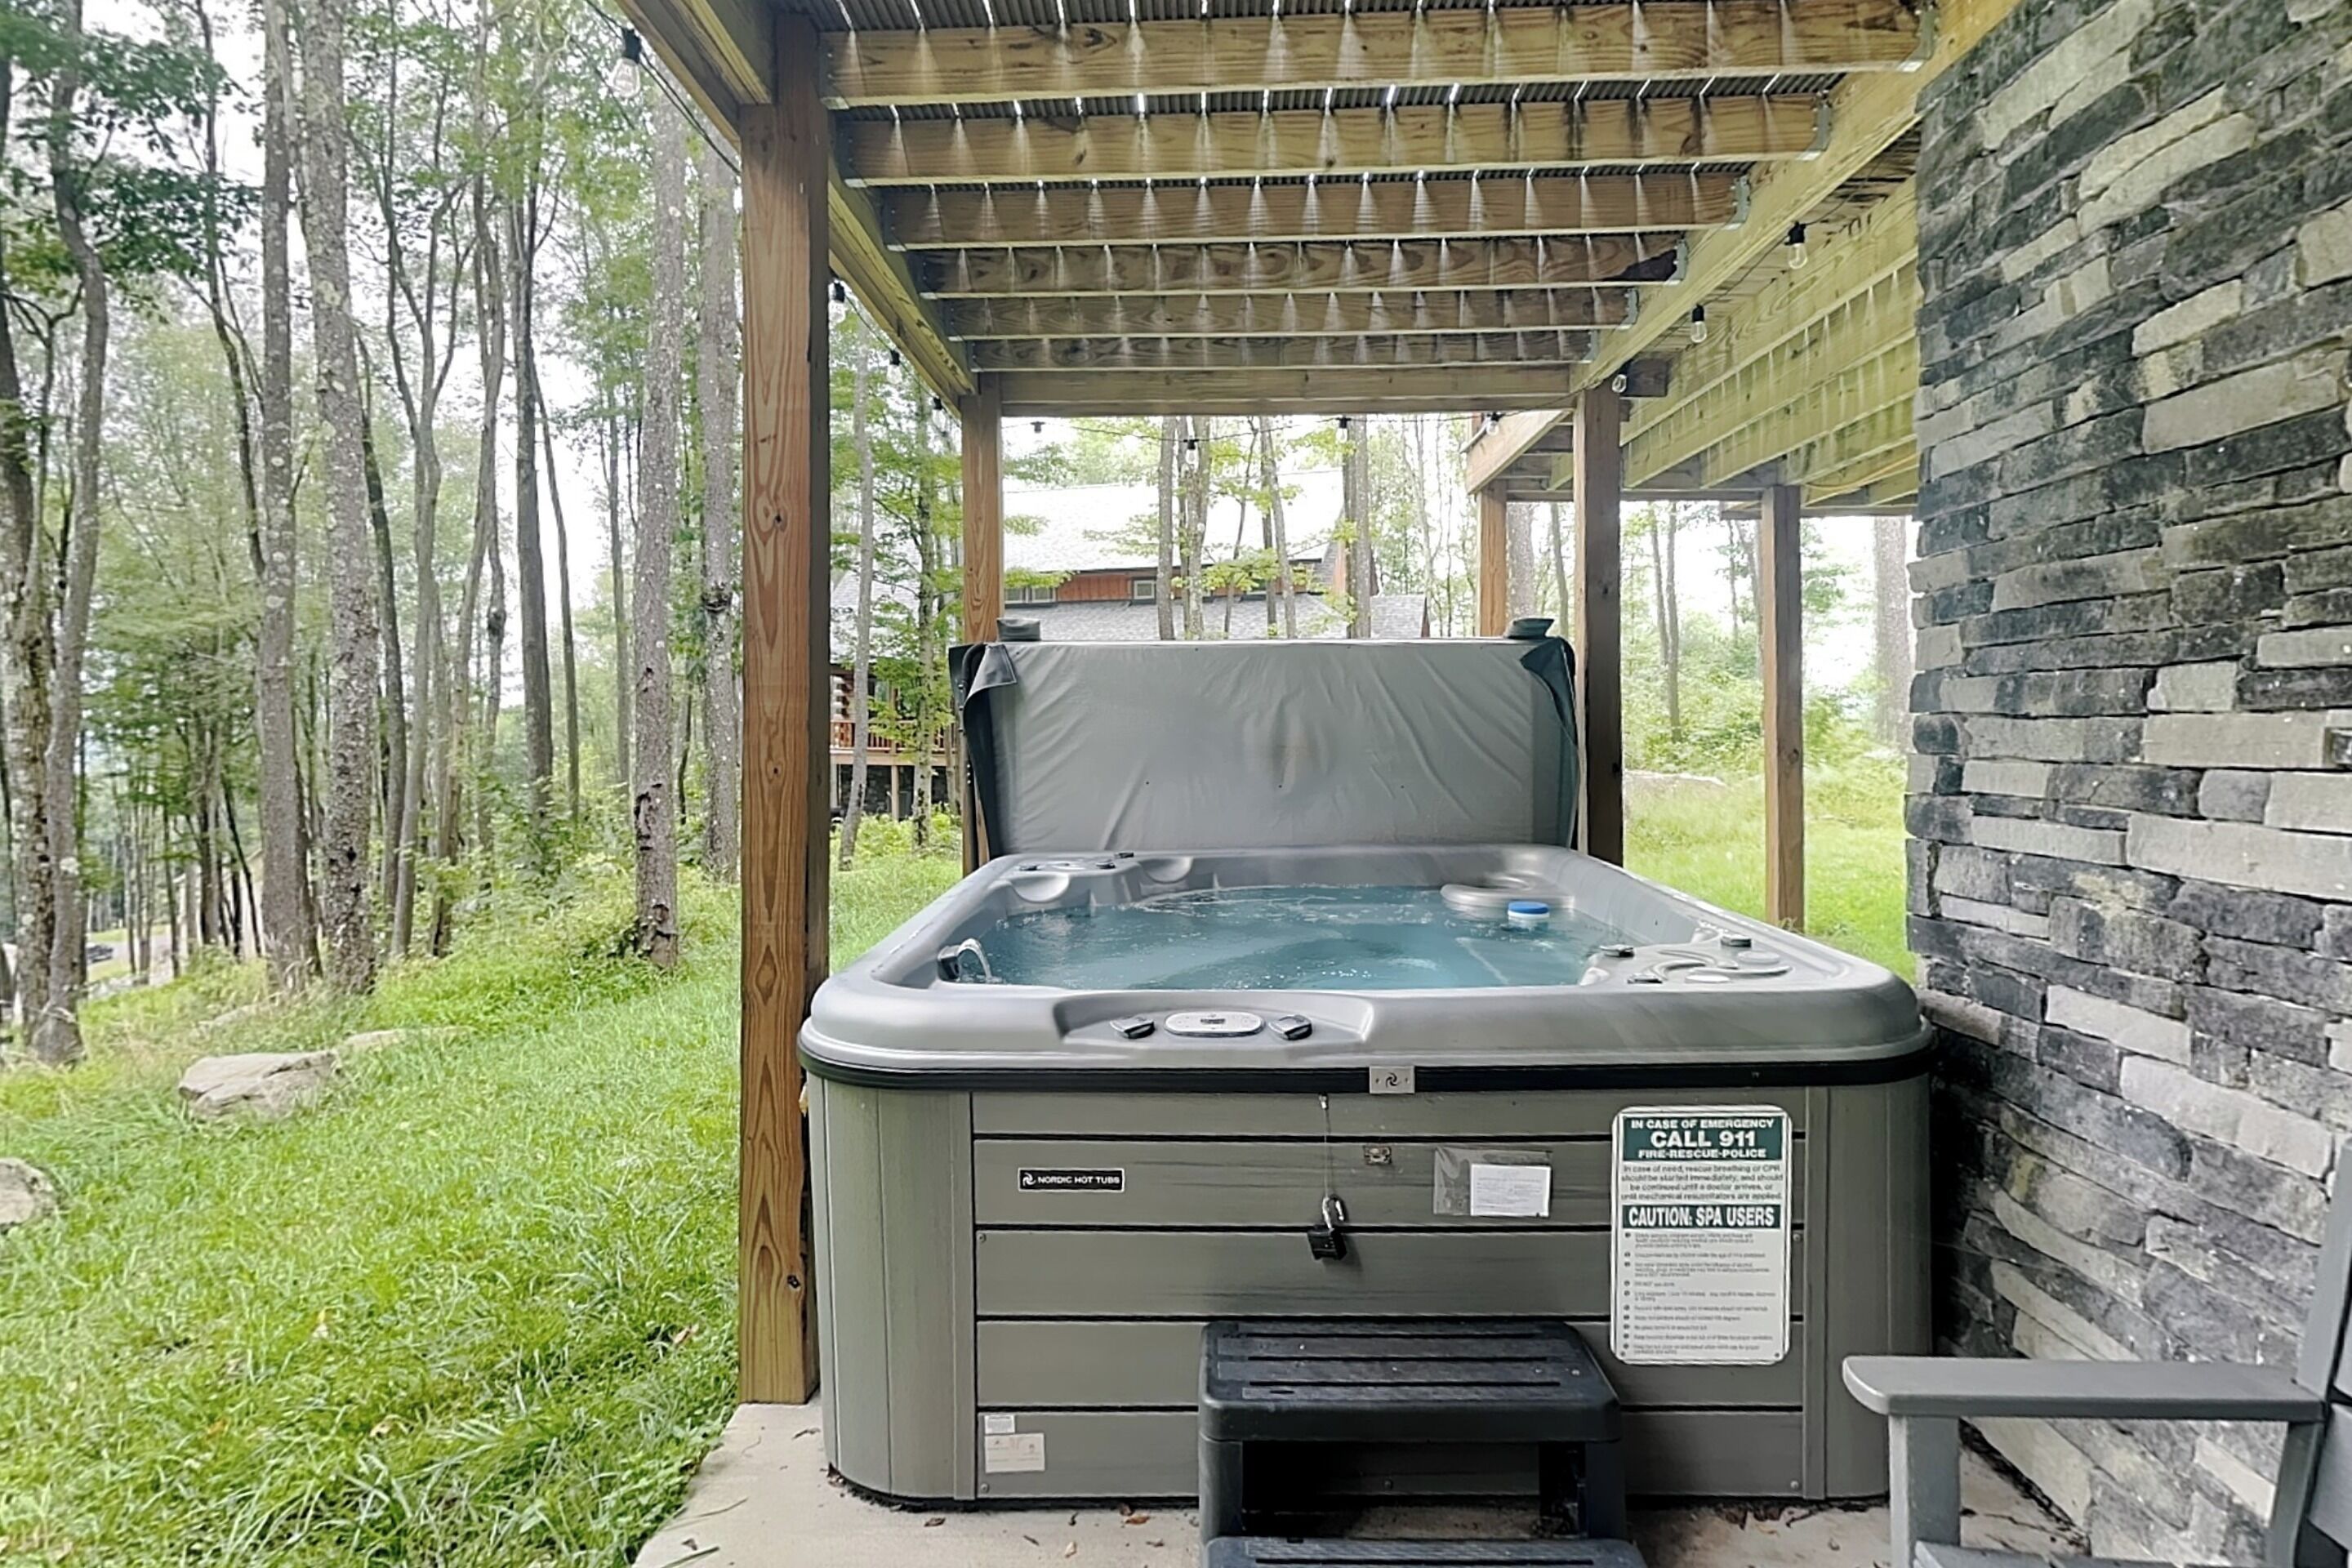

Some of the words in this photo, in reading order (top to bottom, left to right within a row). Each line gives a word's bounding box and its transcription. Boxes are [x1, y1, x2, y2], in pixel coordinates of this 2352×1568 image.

[1631, 1120, 1643, 1129] IN
[1646, 1120, 1678, 1129] CASE
[1682, 1119, 1696, 1129] OF
[1700, 1119, 1774, 1129] EMERGENCY
[1650, 1130, 1712, 1147] CALL
[1719, 1130, 1756, 1147] 911
[1638, 1149, 1766, 1159] FIRE-RESCUE-POLICE
[1037, 1176, 1072, 1184] NORDIC
[1074, 1176, 1093, 1184] HOT
[1095, 1176, 1120, 1184] TUBS
[1696, 1206, 1722, 1226] SPA
[1726, 1206, 1775, 1226] USERS
